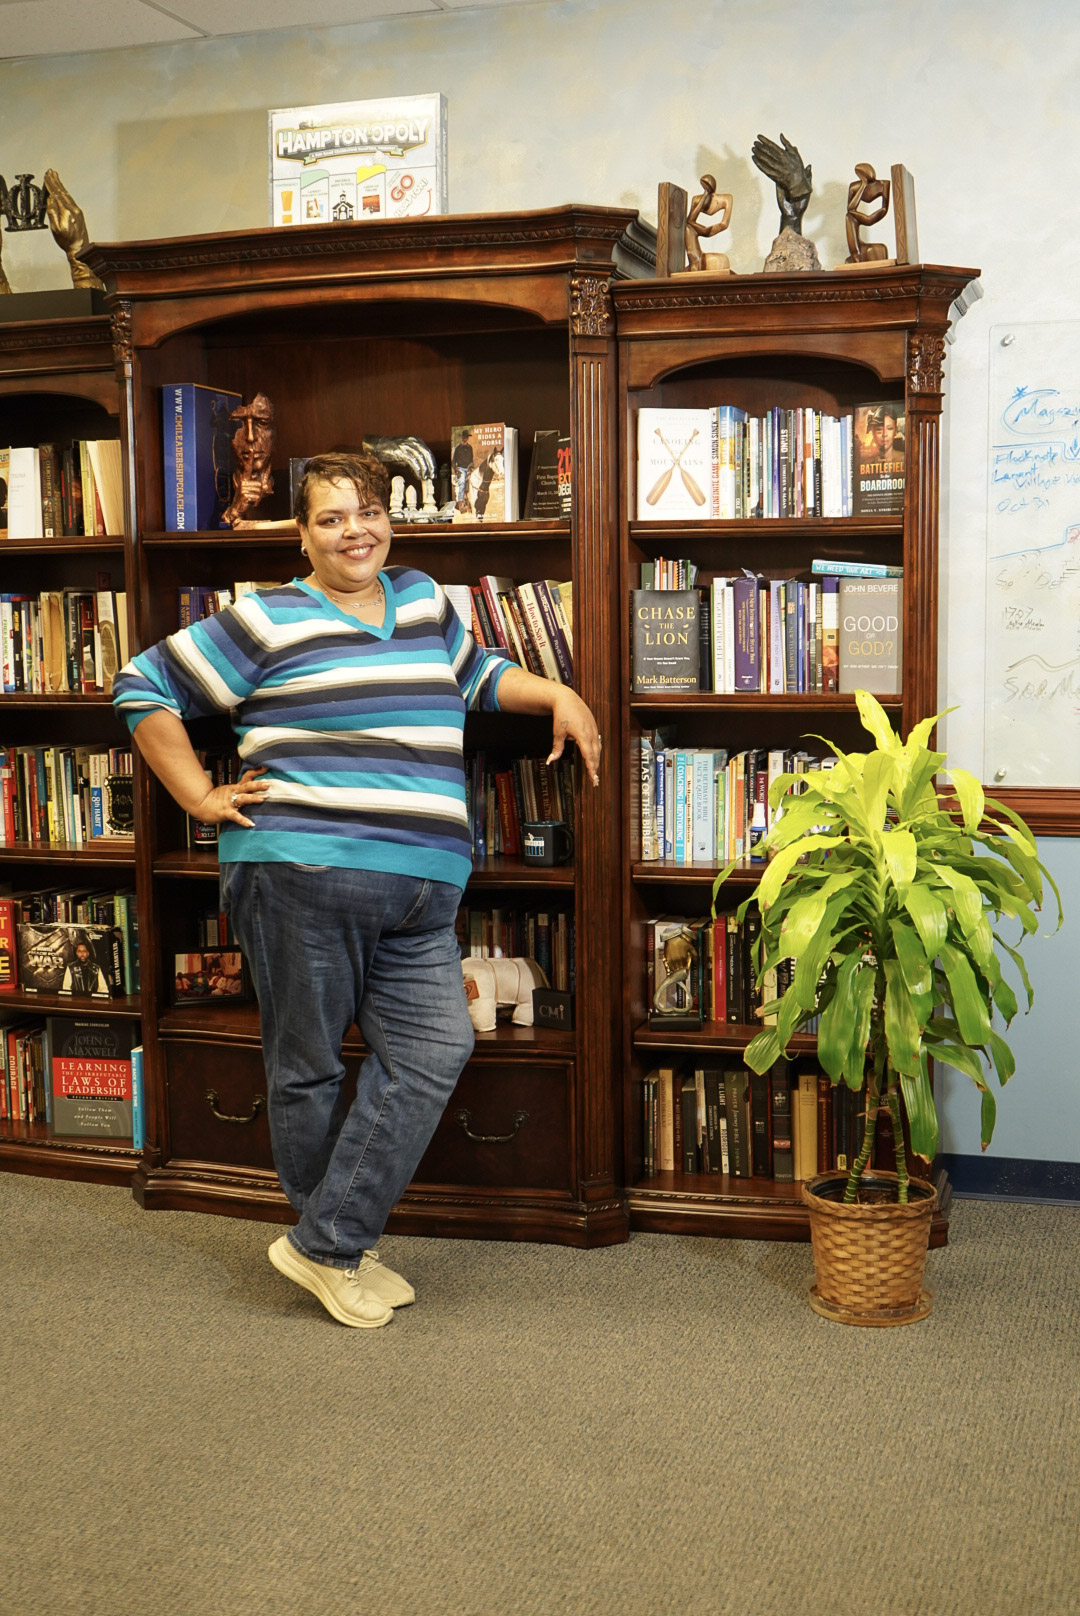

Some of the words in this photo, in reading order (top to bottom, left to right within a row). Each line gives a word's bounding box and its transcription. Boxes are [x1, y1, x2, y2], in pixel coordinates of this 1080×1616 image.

[391, 174, 413, 200] GO
[527, 602, 537, 620] How
[638, 607, 696, 620] CHASE
[532, 620, 540, 628] to
[844, 616, 898, 632] GOOD
[534, 627, 545, 644] Say
[645, 632, 688, 645] LION
[539, 640, 547, 648] It
[848, 641, 893, 655] GOD?
[637, 675, 658, 684] Mark
[660, 675, 696, 684] Batterson
[641, 748, 650, 781] ATLAS
[642, 783, 650, 796] OF
[92, 796, 100, 807] 8th
[642, 820, 650, 847] BIBLE
[0, 956, 10, 973] E
[28, 955, 64, 968] WAR
[74, 1036, 101, 1046] JOHN
[105, 1037, 114, 1046] C.
[68, 1047, 118, 1056] MAXWELL
[61, 1062, 127, 1072] LEARNING
[62, 1076, 100, 1086] LAWS
[108, 1078, 126, 1087] OF
[62, 1086, 127, 1095] LEADERSHIP
